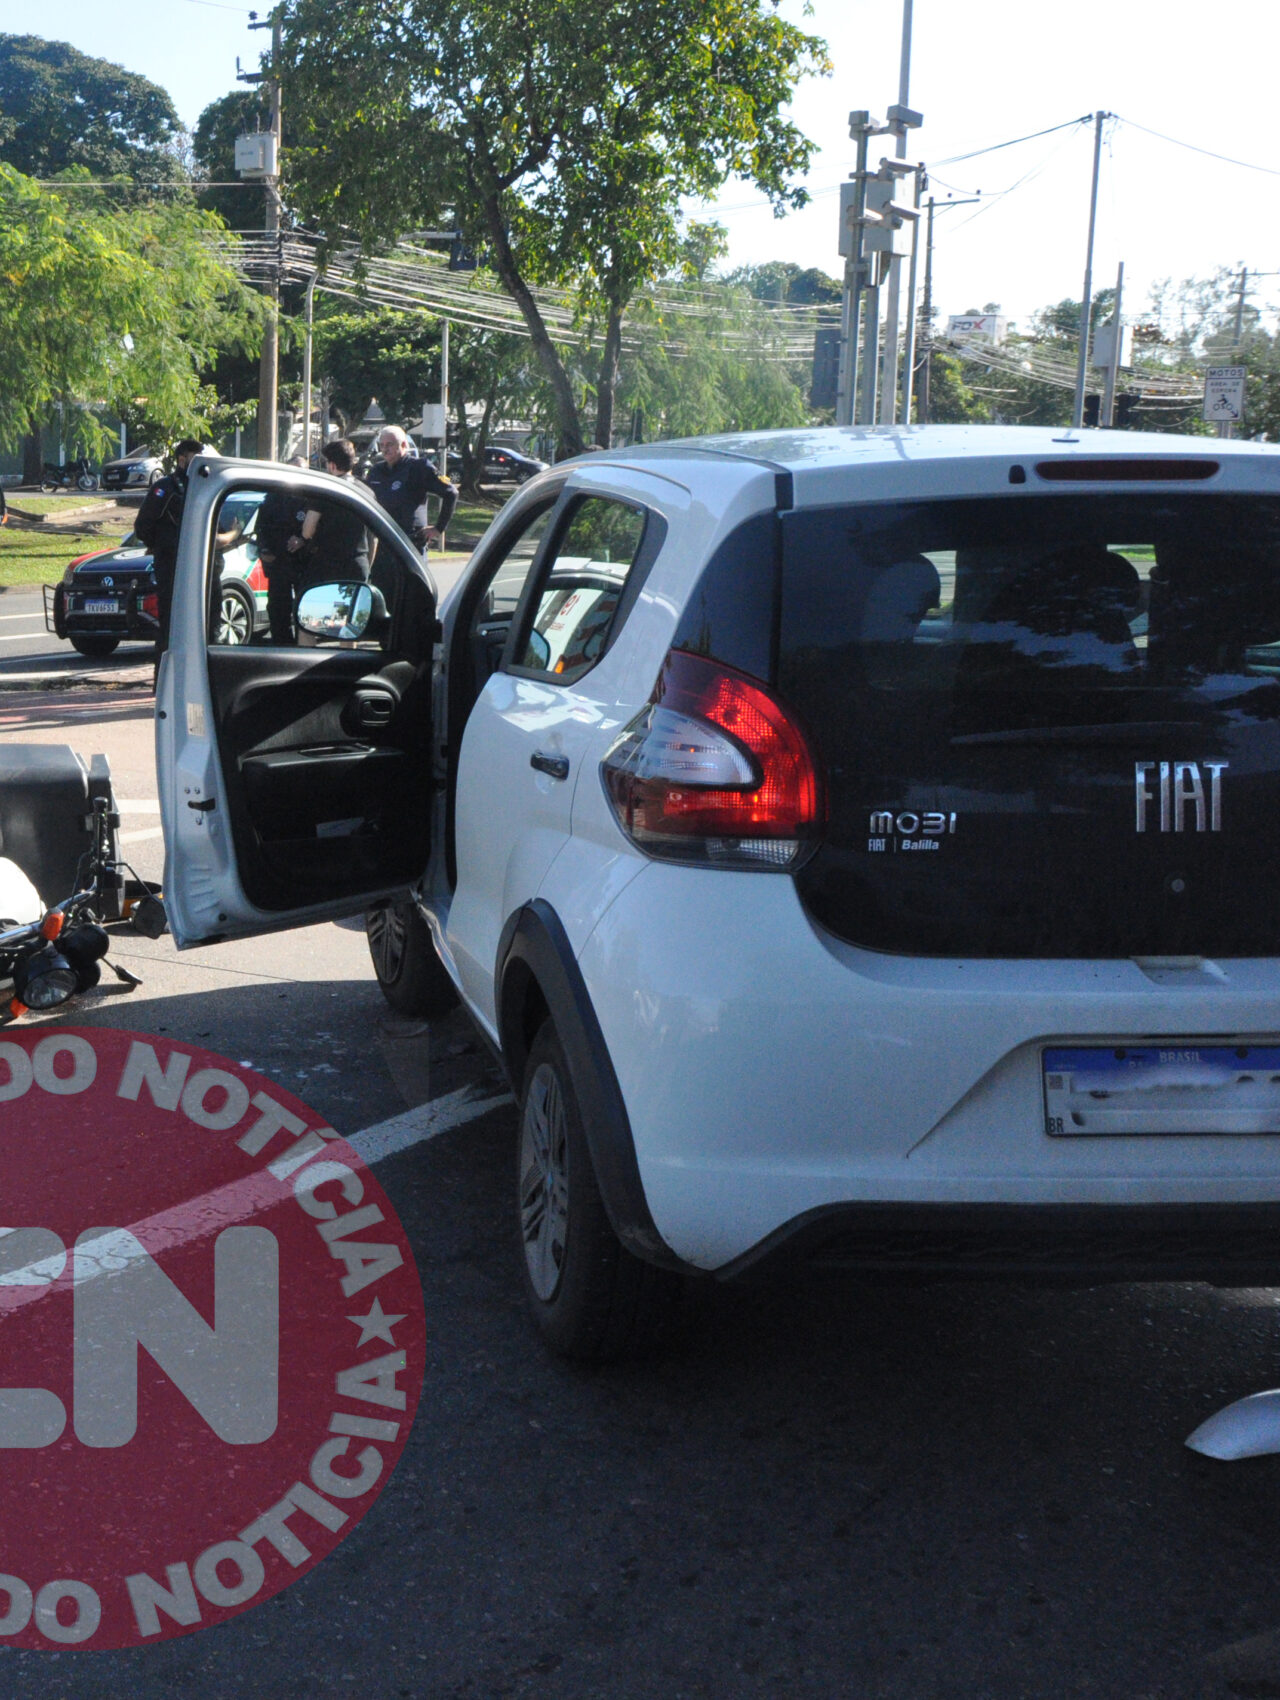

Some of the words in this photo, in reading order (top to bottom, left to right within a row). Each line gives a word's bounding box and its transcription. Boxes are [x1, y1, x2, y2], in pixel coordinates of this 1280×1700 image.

[951, 318, 987, 330] FOX
[1210, 368, 1243, 376] MOTOS
[1135, 761, 1229, 832] FIAT
[868, 838, 886, 852] FIAT
[901, 839, 940, 850] Balilla
[1048, 1117, 1064, 1132] BR
